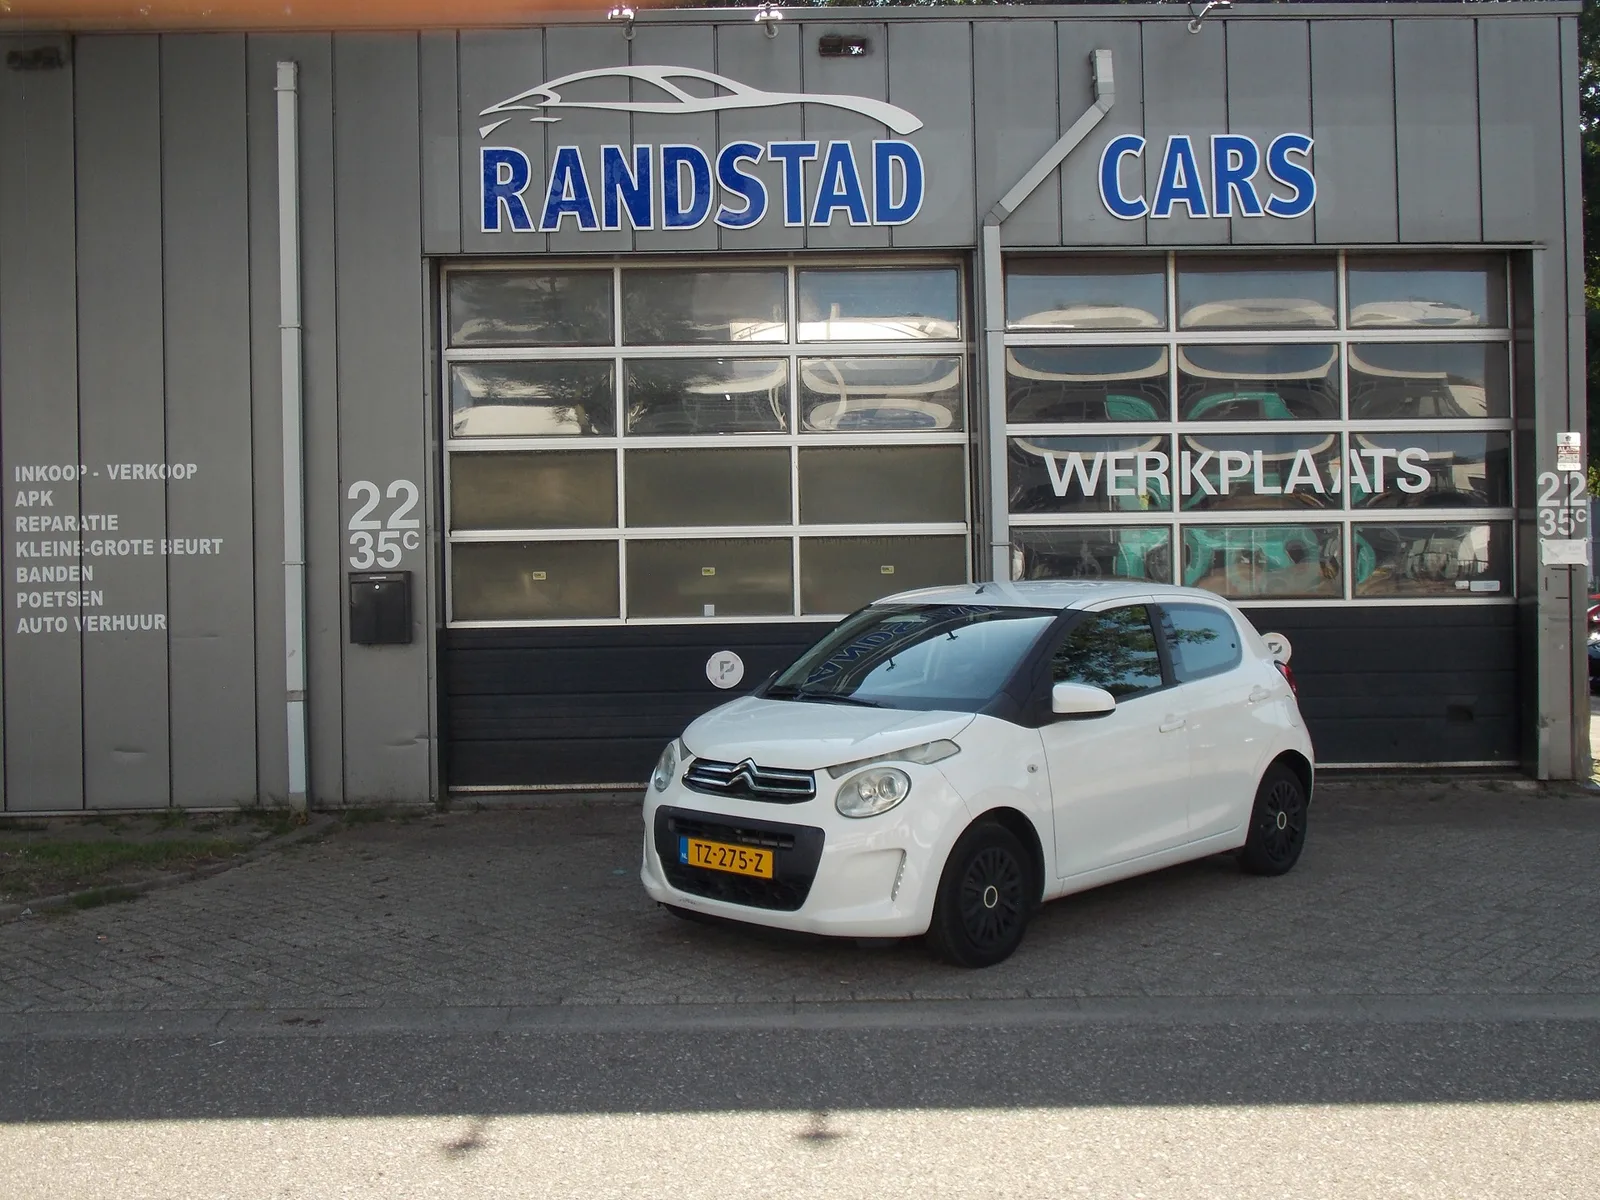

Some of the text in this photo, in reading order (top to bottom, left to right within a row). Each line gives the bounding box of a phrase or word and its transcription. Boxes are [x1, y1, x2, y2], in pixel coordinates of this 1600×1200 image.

[480, 133, 1317, 233] RANDSTAD CARS
[15, 464, 88, 482] INKOOP
[107, 463, 198, 480] VERKOOP
[1043, 447, 1432, 498] WERKPLAATS
[15, 490, 54, 507] APK
[1537, 471, 1587, 507] 22
[347, 479, 420, 530] 22
[15, 514, 119, 532] REPARATIE
[16, 538, 223, 558] KLEINE-GROTE BEURT
[16, 565, 94, 583] BANDEN
[17, 590, 104, 608] POETSEN
[17, 613, 167, 634] AUTO VERHUUR
[694, 843, 764, 873] TZ-275-Z
